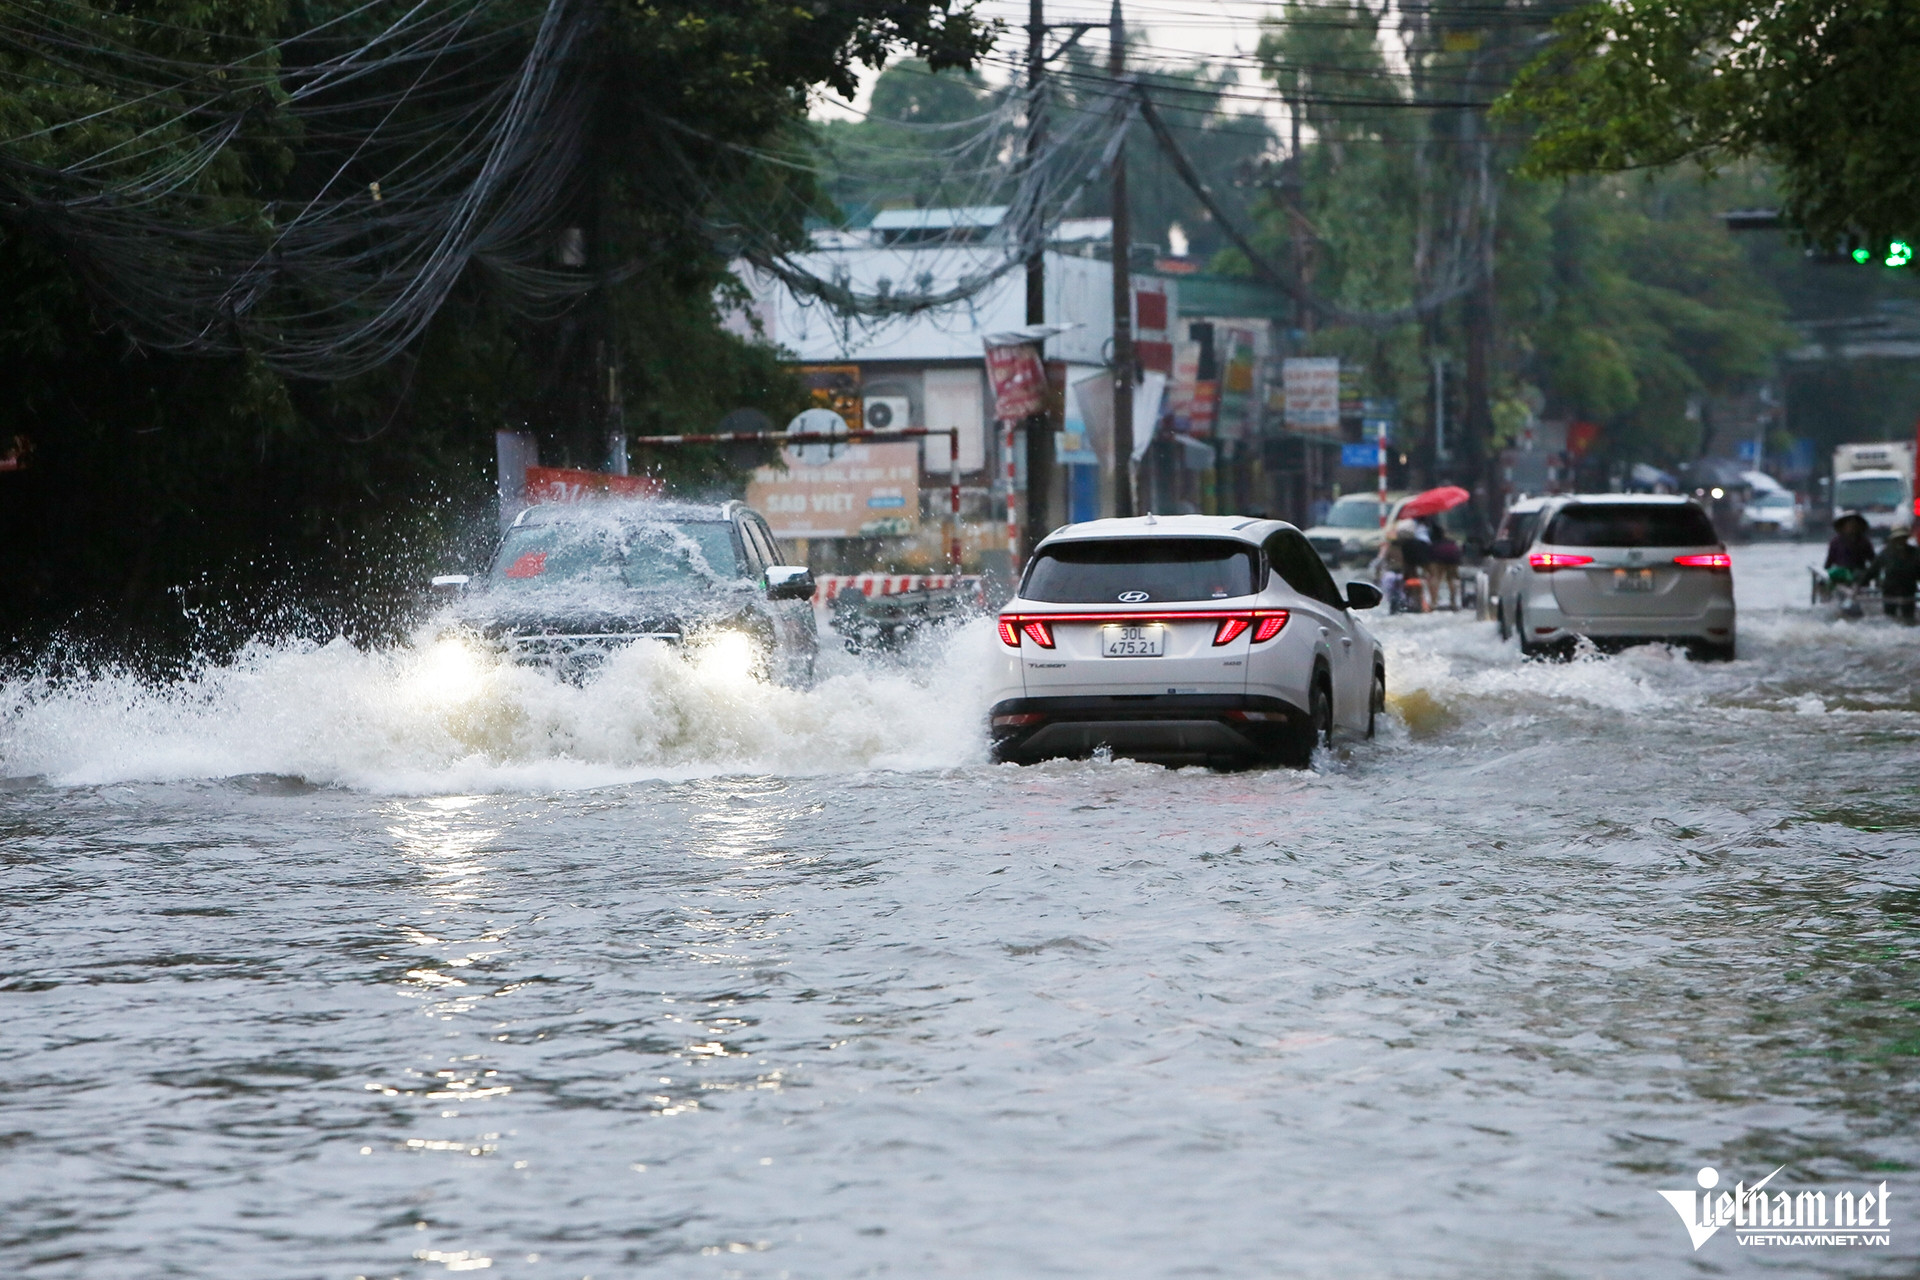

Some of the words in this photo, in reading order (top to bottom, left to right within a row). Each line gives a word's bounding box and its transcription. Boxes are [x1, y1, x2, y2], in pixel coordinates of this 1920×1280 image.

[767, 493, 807, 512] SAO
[1121, 627, 1146, 640] 30L
[1109, 641, 1155, 654] 475.21
